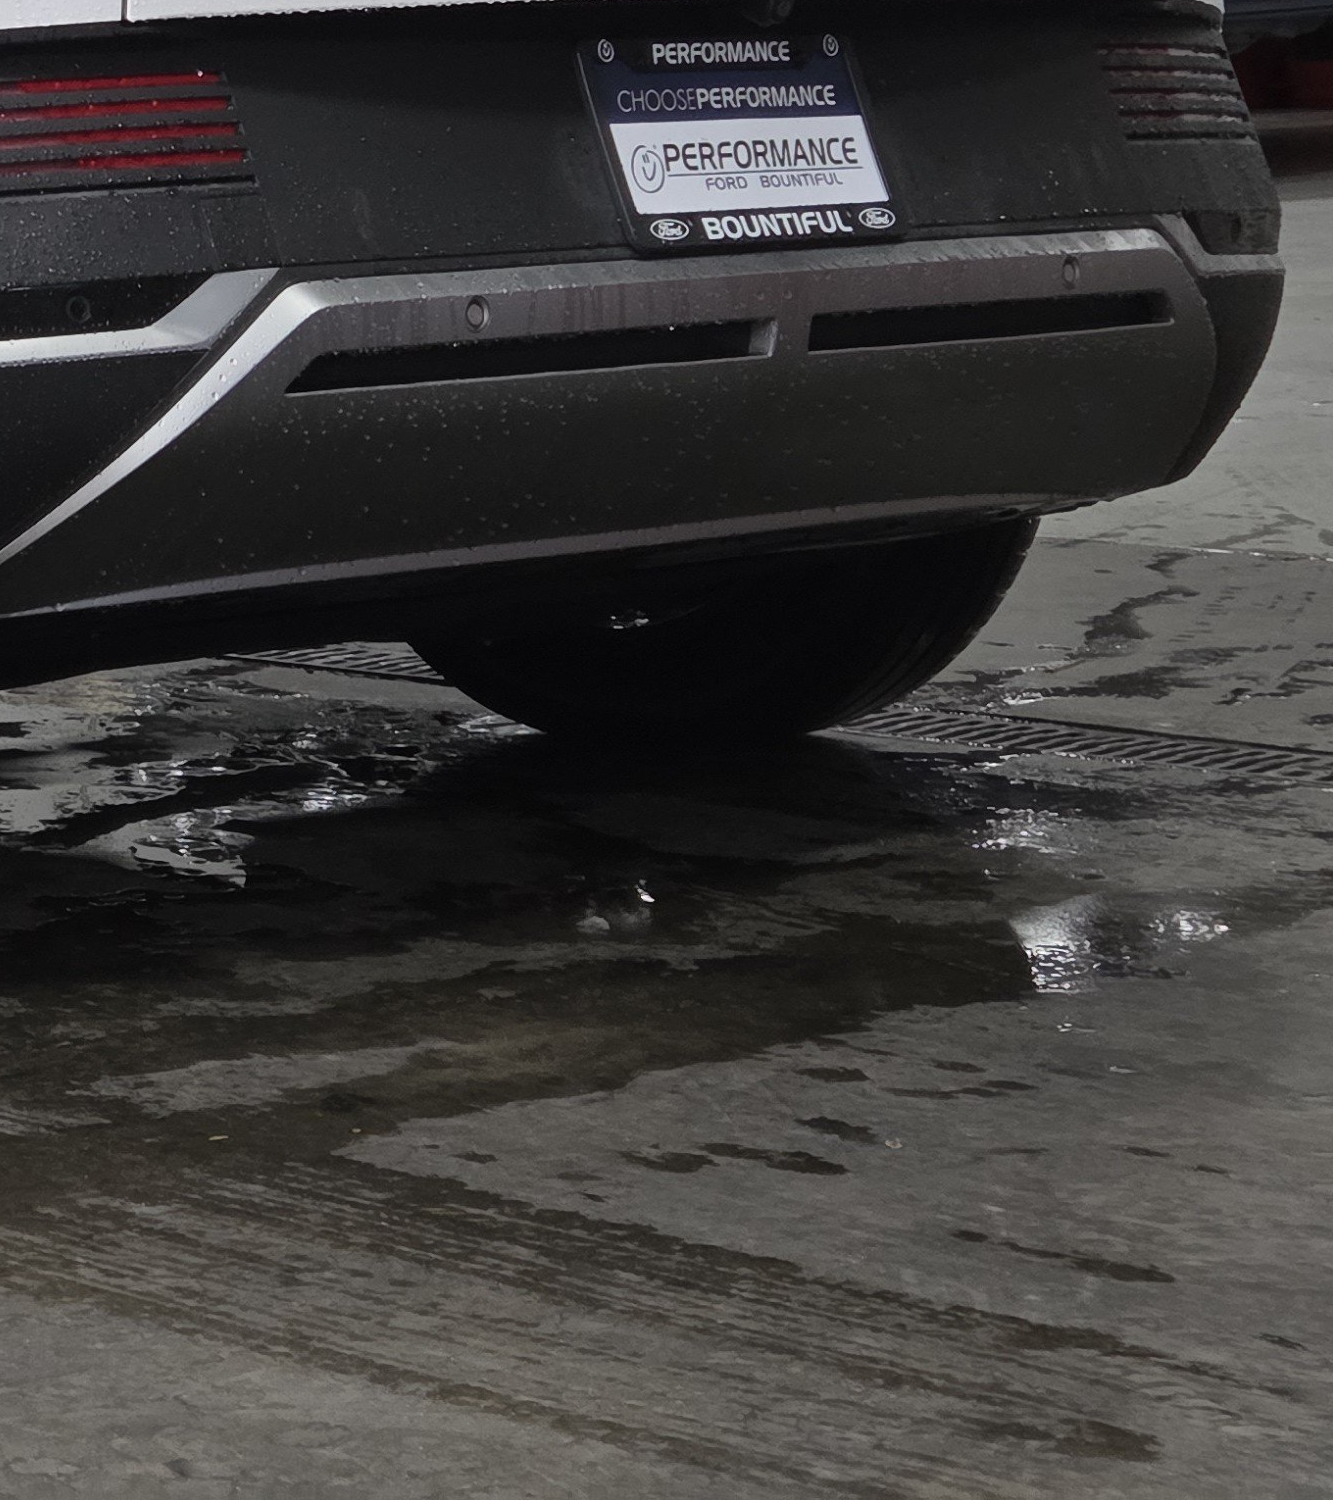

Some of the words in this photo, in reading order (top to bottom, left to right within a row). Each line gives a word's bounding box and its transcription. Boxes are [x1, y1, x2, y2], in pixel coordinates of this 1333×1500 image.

[652, 40, 791, 65] PERFORMANCE
[663, 137, 859, 172] PERFORMANCE
[705, 176, 749, 191] FORD
[760, 172, 844, 189] BOUNTIFUL
[701, 210, 854, 240] BOUNTIFUL
